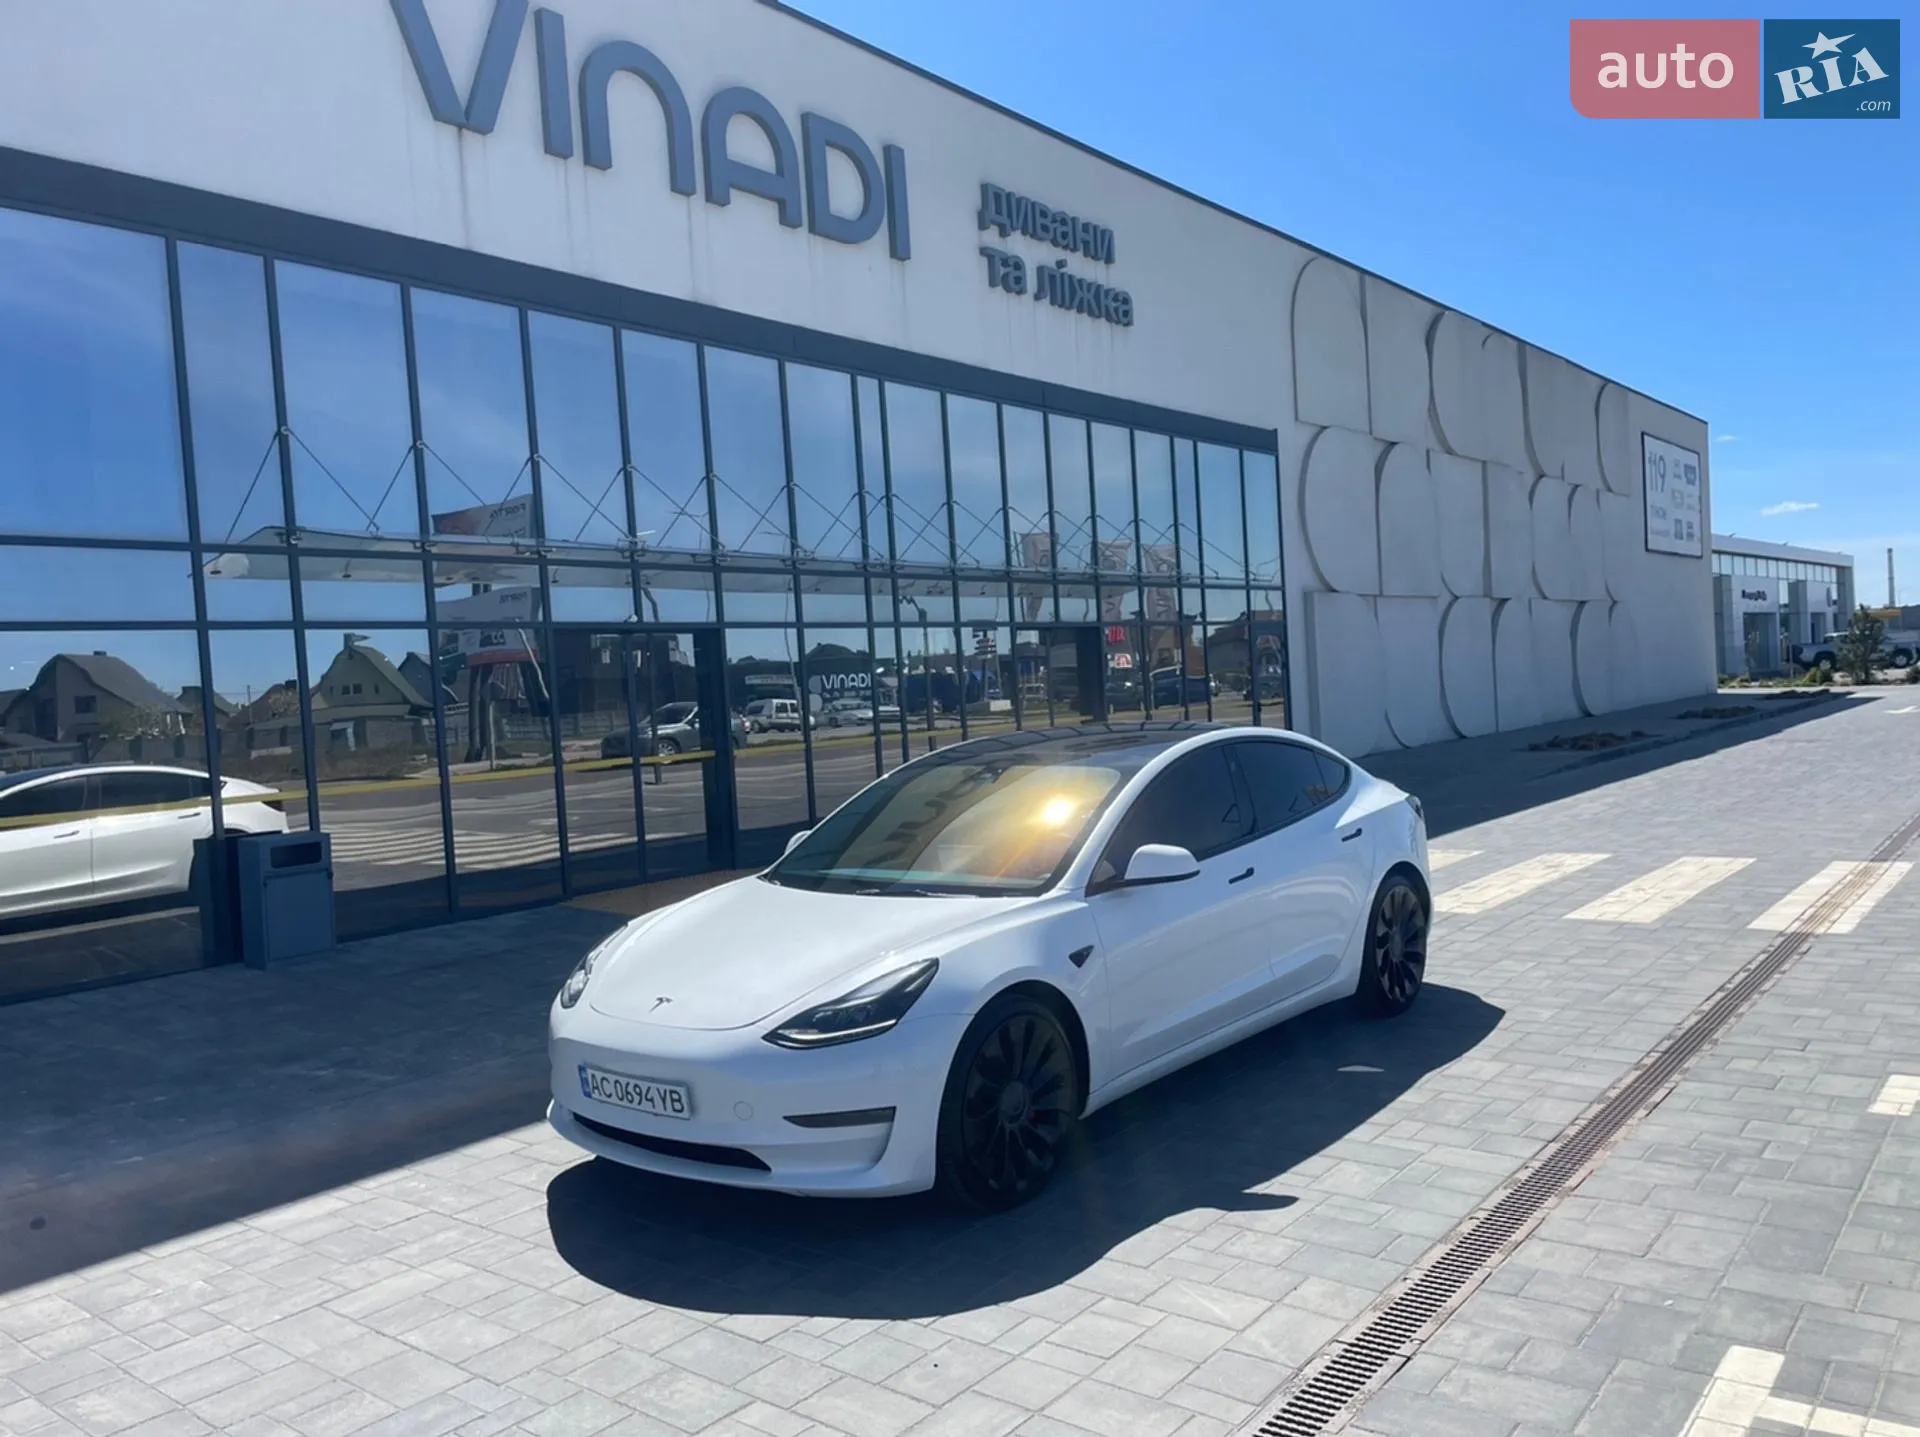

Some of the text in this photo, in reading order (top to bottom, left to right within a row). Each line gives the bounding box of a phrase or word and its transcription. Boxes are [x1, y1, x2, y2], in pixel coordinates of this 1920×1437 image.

[389, 0, 911, 260] VINADI
[978, 182, 1116, 265] дивани
[979, 246, 1134, 327] та ліжка
[822, 673, 872, 689] VINADI
